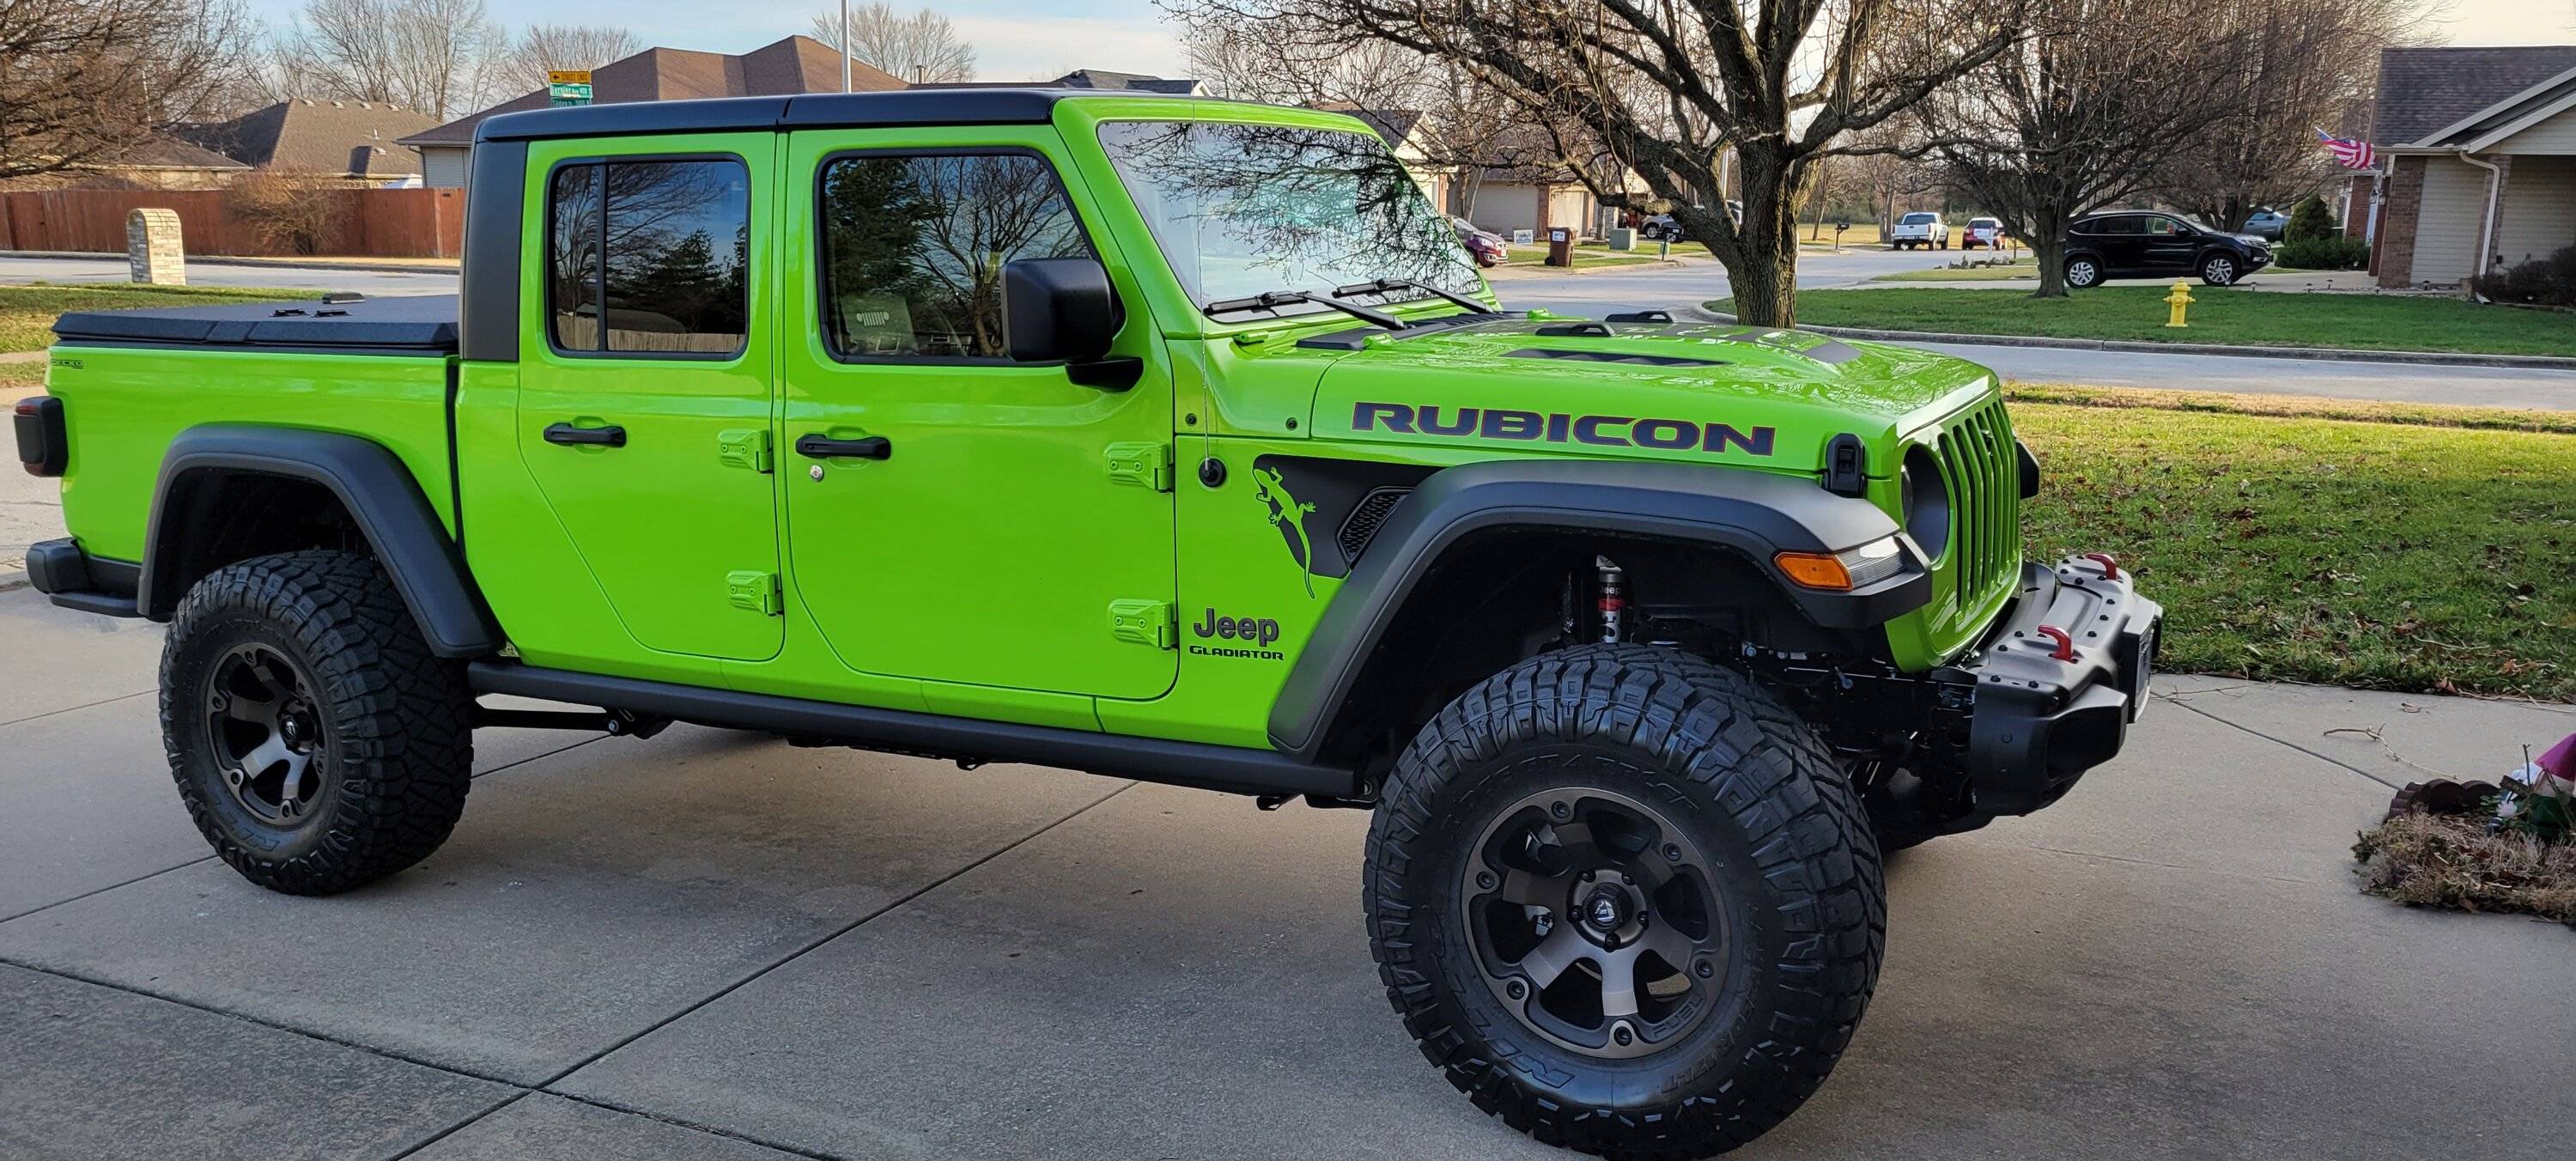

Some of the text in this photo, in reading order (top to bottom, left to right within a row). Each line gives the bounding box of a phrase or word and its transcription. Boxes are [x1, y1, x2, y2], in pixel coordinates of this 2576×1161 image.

[1352, 401, 1777, 457] RUBICON
[1600, 586, 1621, 595] Jeep
[1193, 607, 1279, 647] Jeep
[1188, 646, 1285, 660] GLADIATOR
